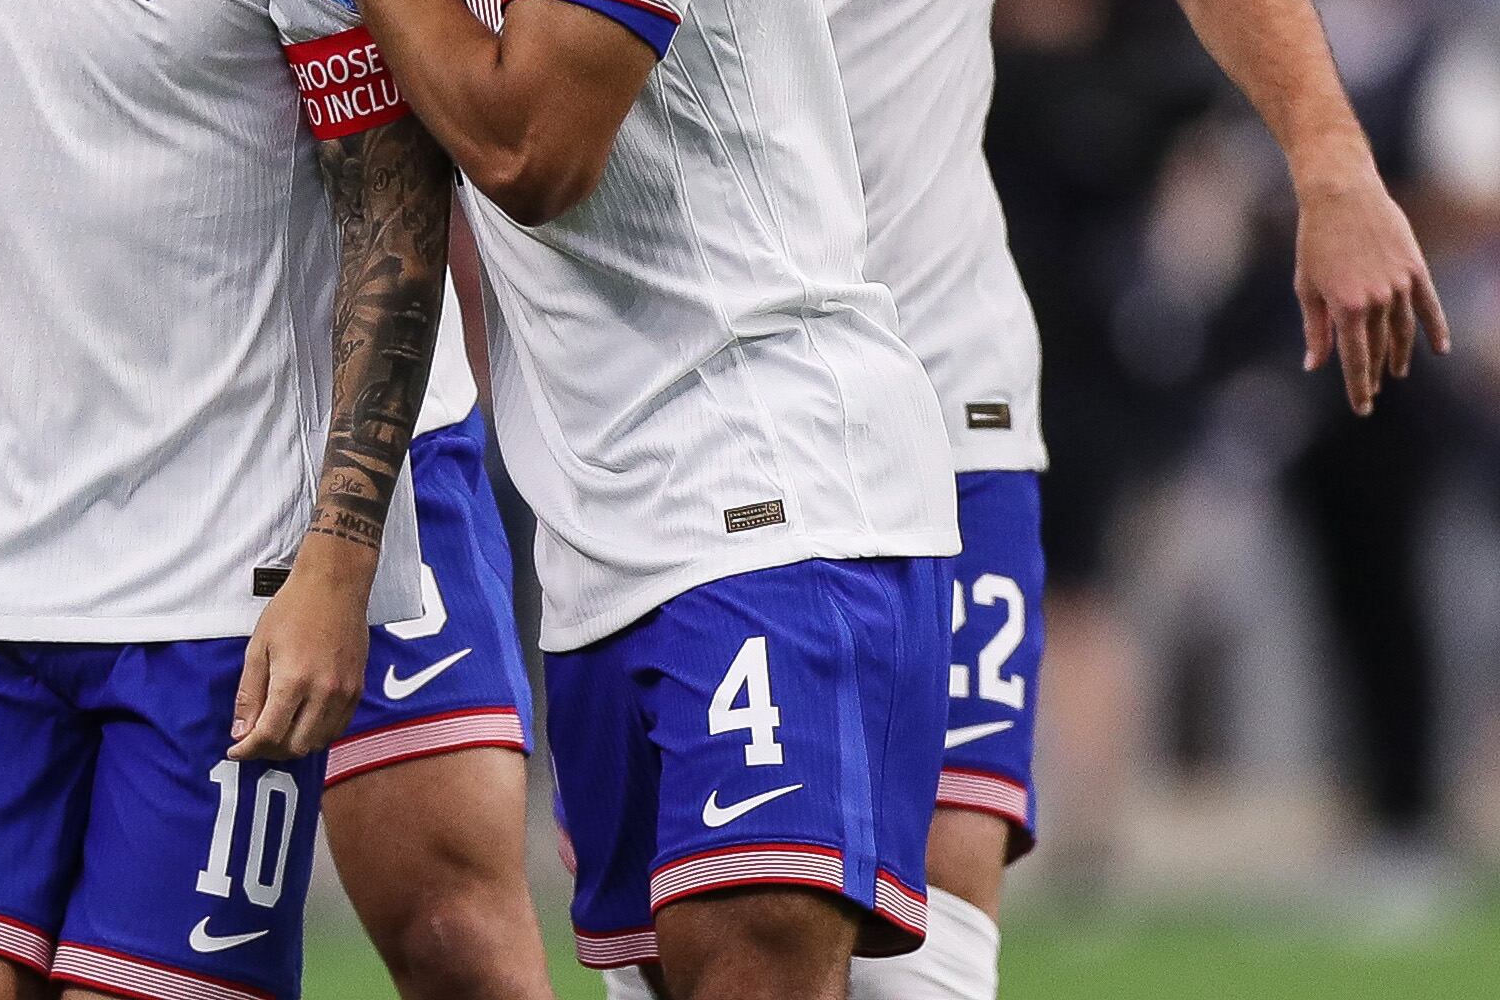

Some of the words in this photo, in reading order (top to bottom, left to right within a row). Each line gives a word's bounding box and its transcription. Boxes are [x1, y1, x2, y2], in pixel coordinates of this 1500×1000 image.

[290, 43, 384, 92] HOOSE
[324, 79, 402, 125] INCLU
[708, 635, 784, 766] 4
[196, 759, 299, 908] 10
